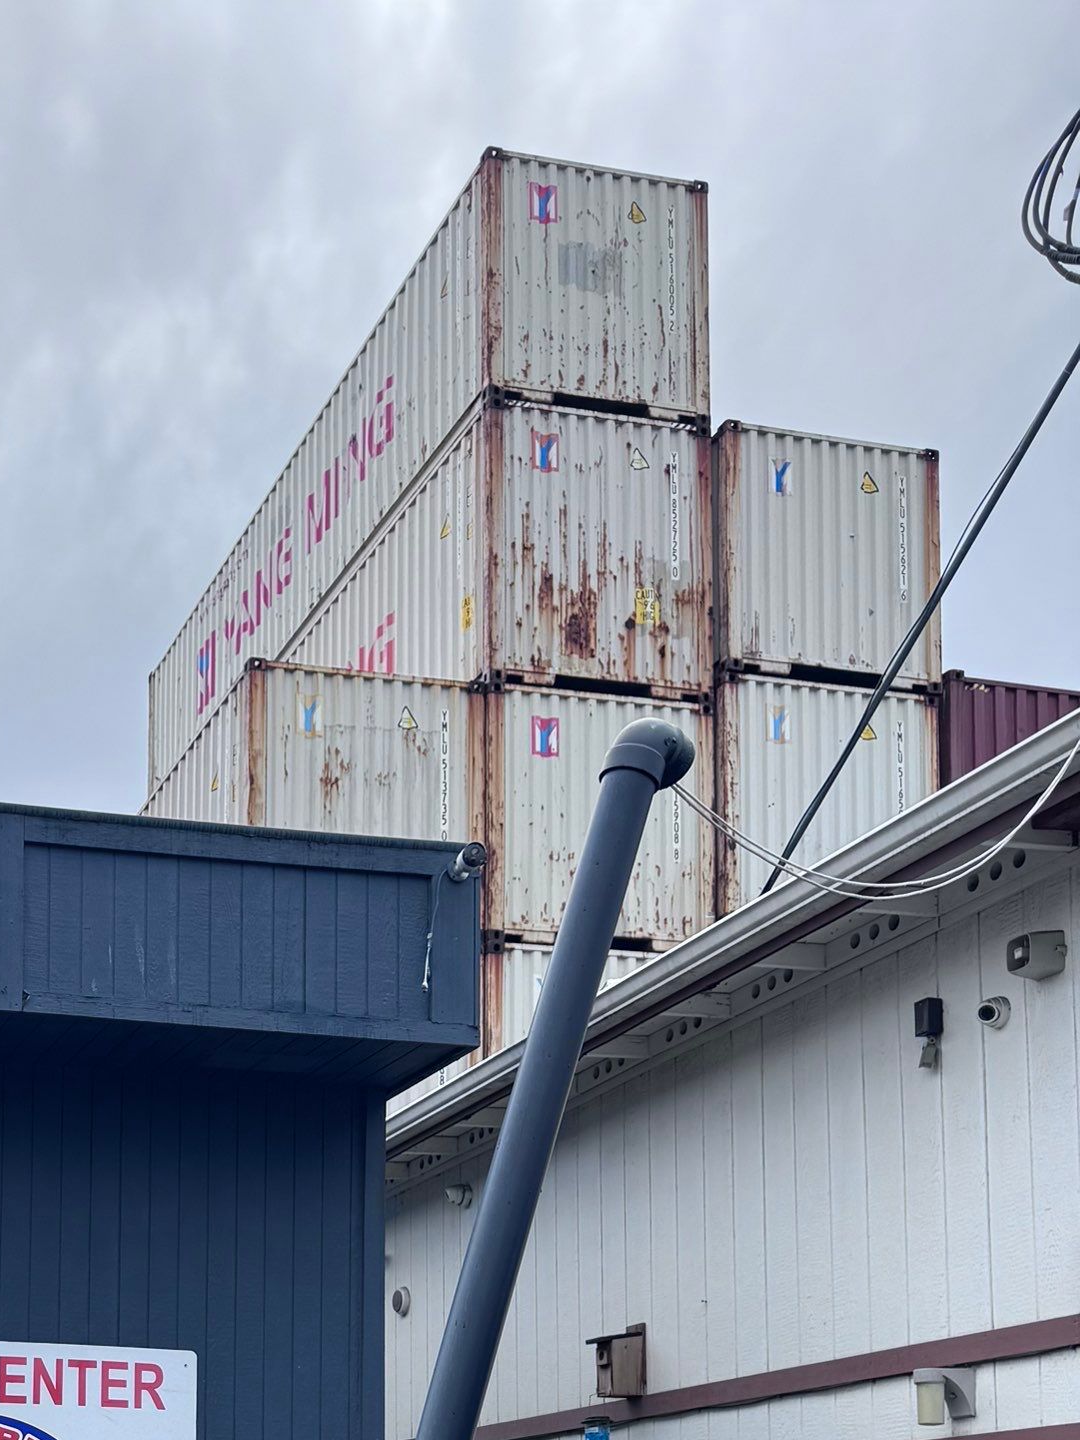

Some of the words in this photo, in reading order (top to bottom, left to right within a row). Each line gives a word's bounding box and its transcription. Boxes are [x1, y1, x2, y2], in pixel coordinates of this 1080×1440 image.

[667, 207, 675, 250] YMLU
[668, 254, 676, 316] 516005
[307, 375, 395, 555] MING
[899, 522, 907, 586] 515621
[441, 710, 449, 755] YMLU
[441, 758, 449, 826] 513735
[441, 830, 448, 842] 0
